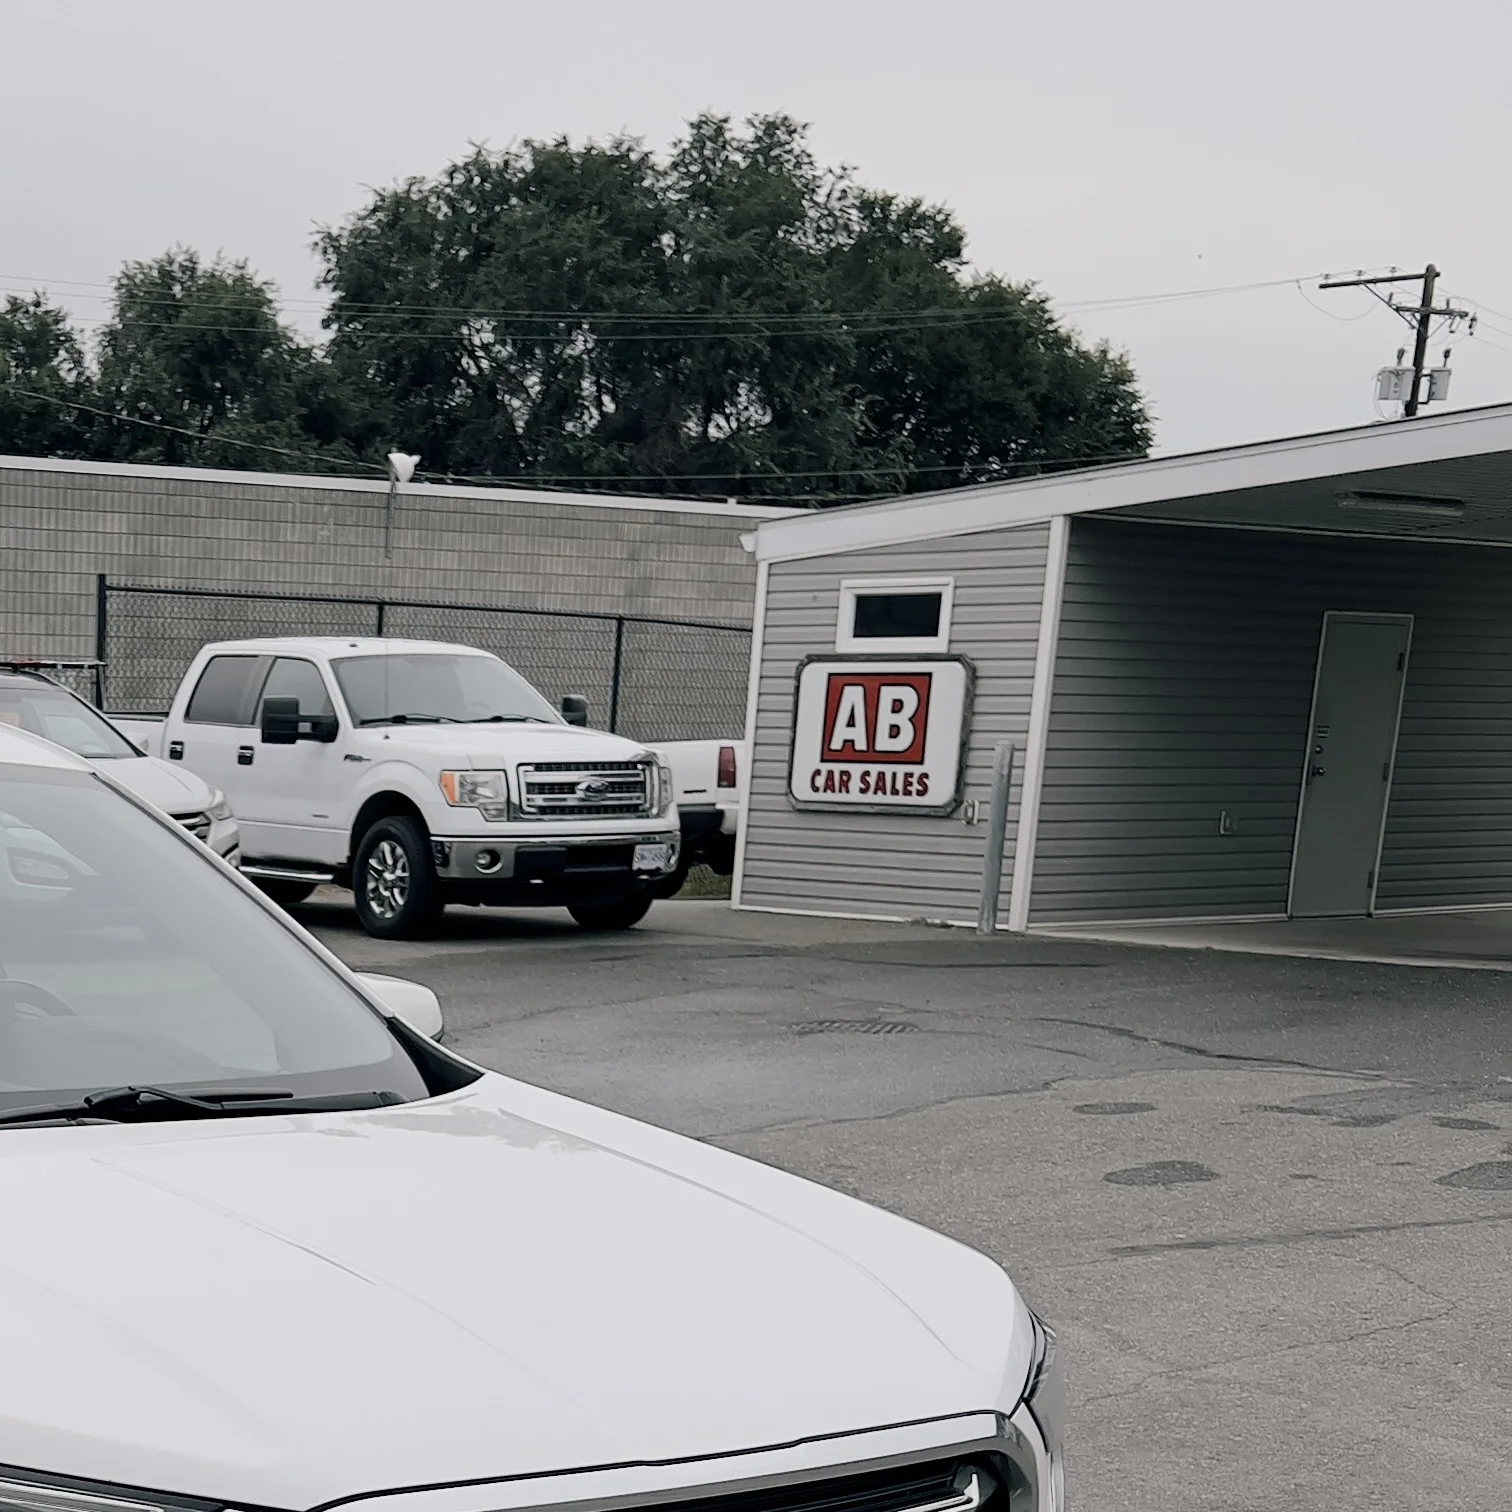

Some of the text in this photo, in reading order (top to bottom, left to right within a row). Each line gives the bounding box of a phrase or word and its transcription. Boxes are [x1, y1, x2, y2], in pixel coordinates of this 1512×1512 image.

[828, 683, 920, 754] AB
[810, 768, 930, 797] CAR SALES
